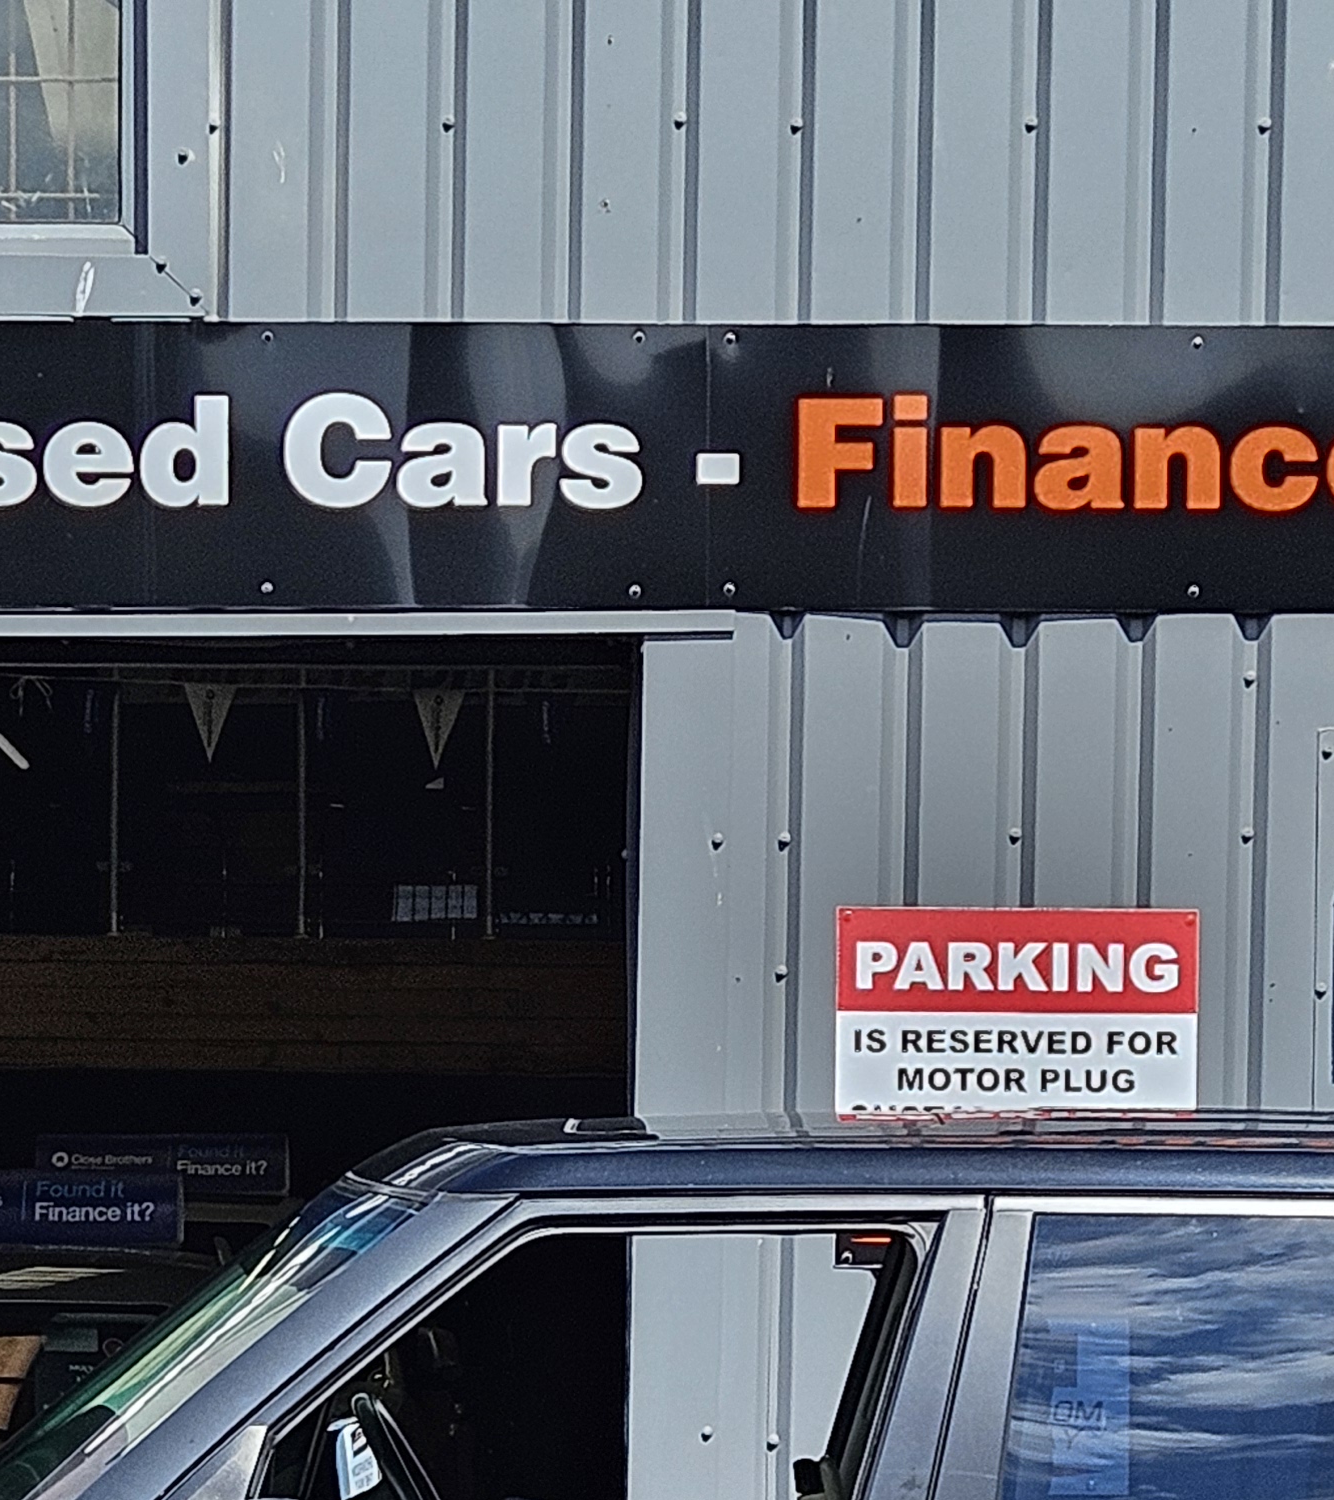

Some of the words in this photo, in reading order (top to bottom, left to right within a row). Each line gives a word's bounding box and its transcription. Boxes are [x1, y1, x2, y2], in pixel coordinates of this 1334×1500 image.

[283, 392, 643, 509] Cars
[695, 453, 741, 485] -
[855, 940, 1180, 993] PARKING
[854, 1028, 887, 1053] IS
[901, 1029, 1092, 1055] RESERVED
[1107, 1030, 1178, 1055] FOR
[897, 1067, 1027, 1093] MOTOR
[1040, 1068, 1136, 1093] PLUG
[176, 1159, 242, 1176] Finance
[245, 1160, 268, 1176] it?
[36, 1180, 107, 1199] Found
[110, 1180, 125, 1198] it
[34, 1201, 121, 1222] Finance
[126, 1201, 155, 1222] it?
